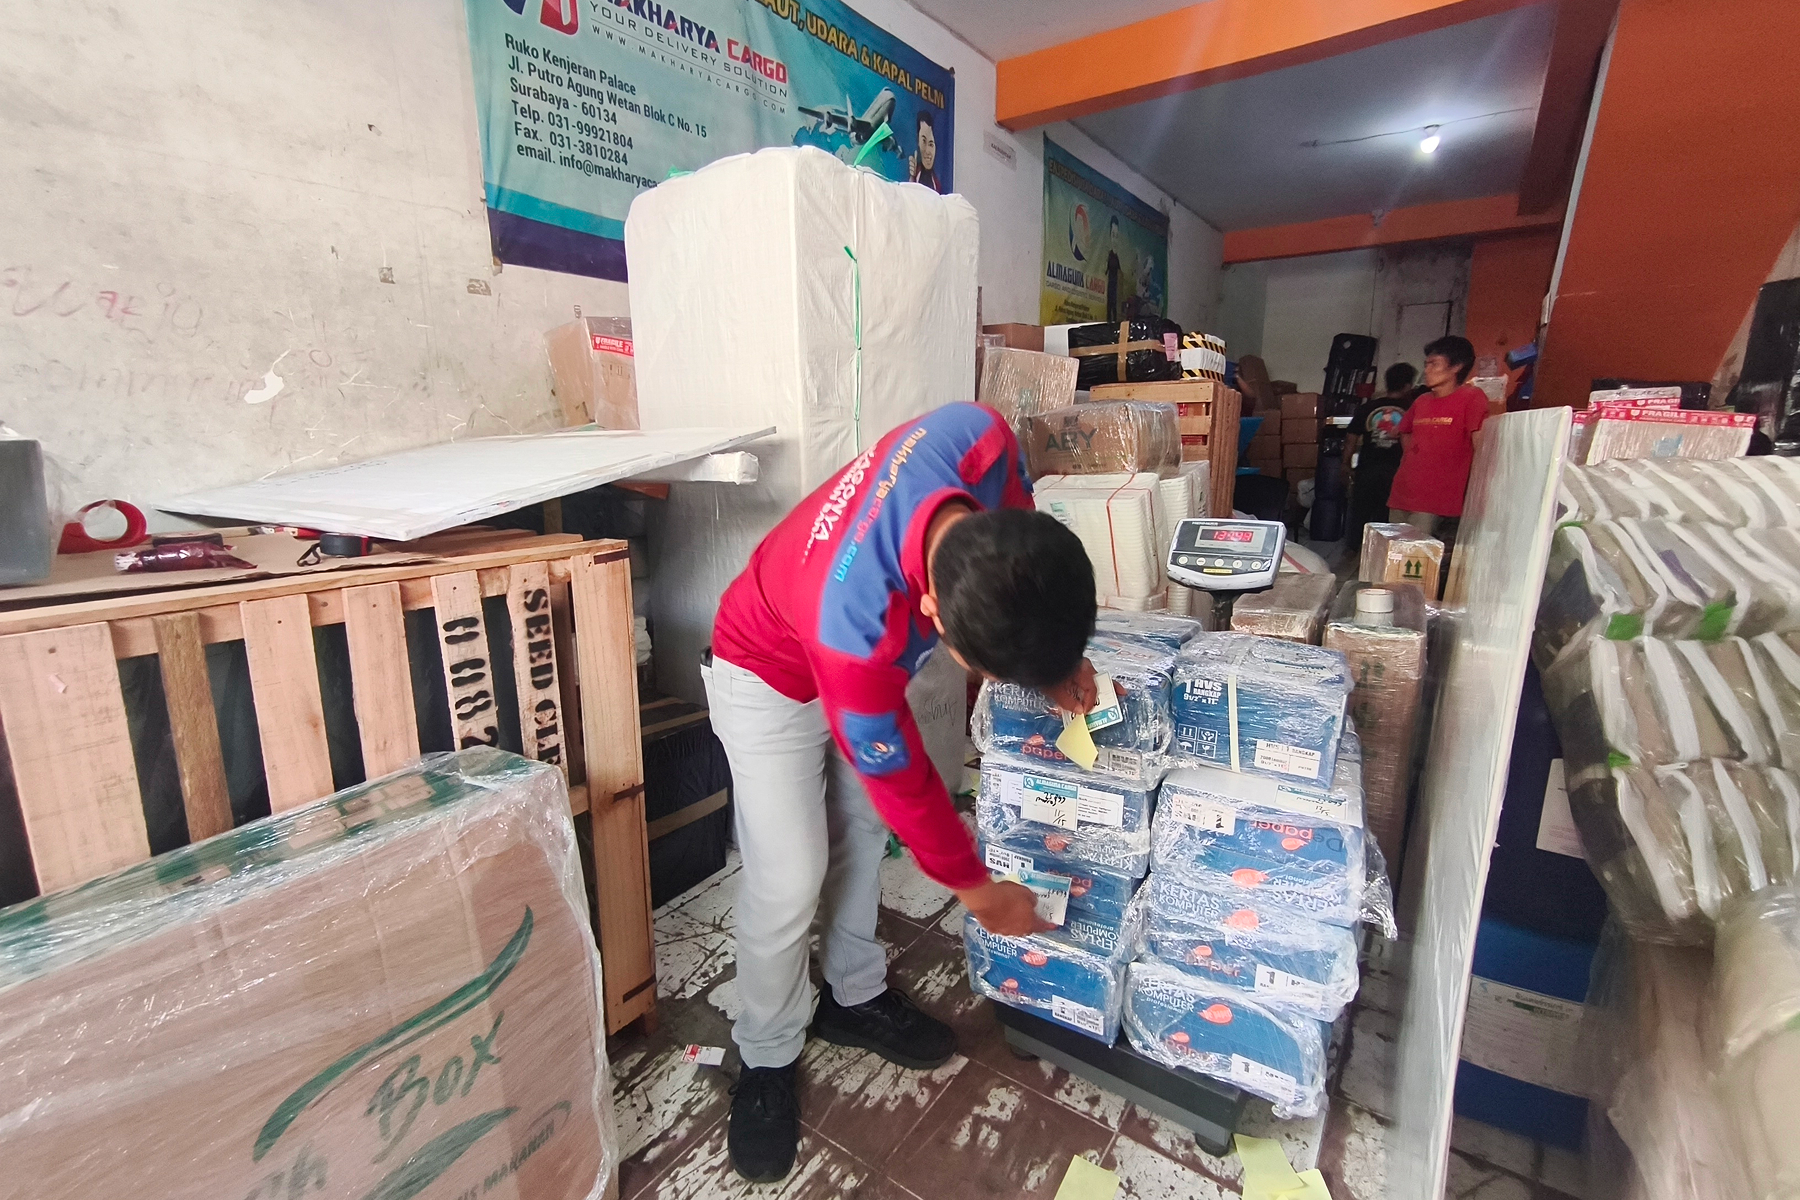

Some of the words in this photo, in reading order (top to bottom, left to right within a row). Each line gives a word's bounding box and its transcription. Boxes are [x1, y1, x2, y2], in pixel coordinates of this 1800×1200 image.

[504, 33, 540, 60] Ruko
[543, 48, 597, 81] Kenjeran
[600, 70, 637, 96] Palace
[590, 0, 637, 31] YOUR
[645, 27, 718, 66] DELIVERY
[723, 62, 788, 98] SOLUTION
[727, 38, 788, 84] CARGO
[806, 10, 860, 65] UDARA
[858, 44, 871, 69] &
[872, 50, 914, 92] KAPAL
[914, 77, 946, 110] PELNI
[508, 56, 524, 74] Jl.
[528, 61, 564, 88] Putro
[567, 77, 604, 106] Agung
[606, 90, 642, 115] Wetan
[644, 106, 666, 125] Blok
[668, 114, 676, 127] C
[677, 117, 693, 134] No.
[695, 123, 708, 139] 15
[510, 77, 570, 111] Surabaya
[581, 102, 618, 126] 60134
[511, 100, 545, 124] Telp.
[547, 112, 634, 150] 031-99921804
[514, 122, 543, 142] Fax.
[549, 131, 629, 165] 031-3810284
[516, 143, 556, 164] email.
[559, 153, 661, 189] info@makharyaca
[1642, 409, 1687, 419] FRAGILE
[523, 588, 555, 690] SEED
[1194, 679, 1223, 692] HVS
[1160, 881, 1220, 910] KERTAS
[363, 1010, 505, 1165] Box
